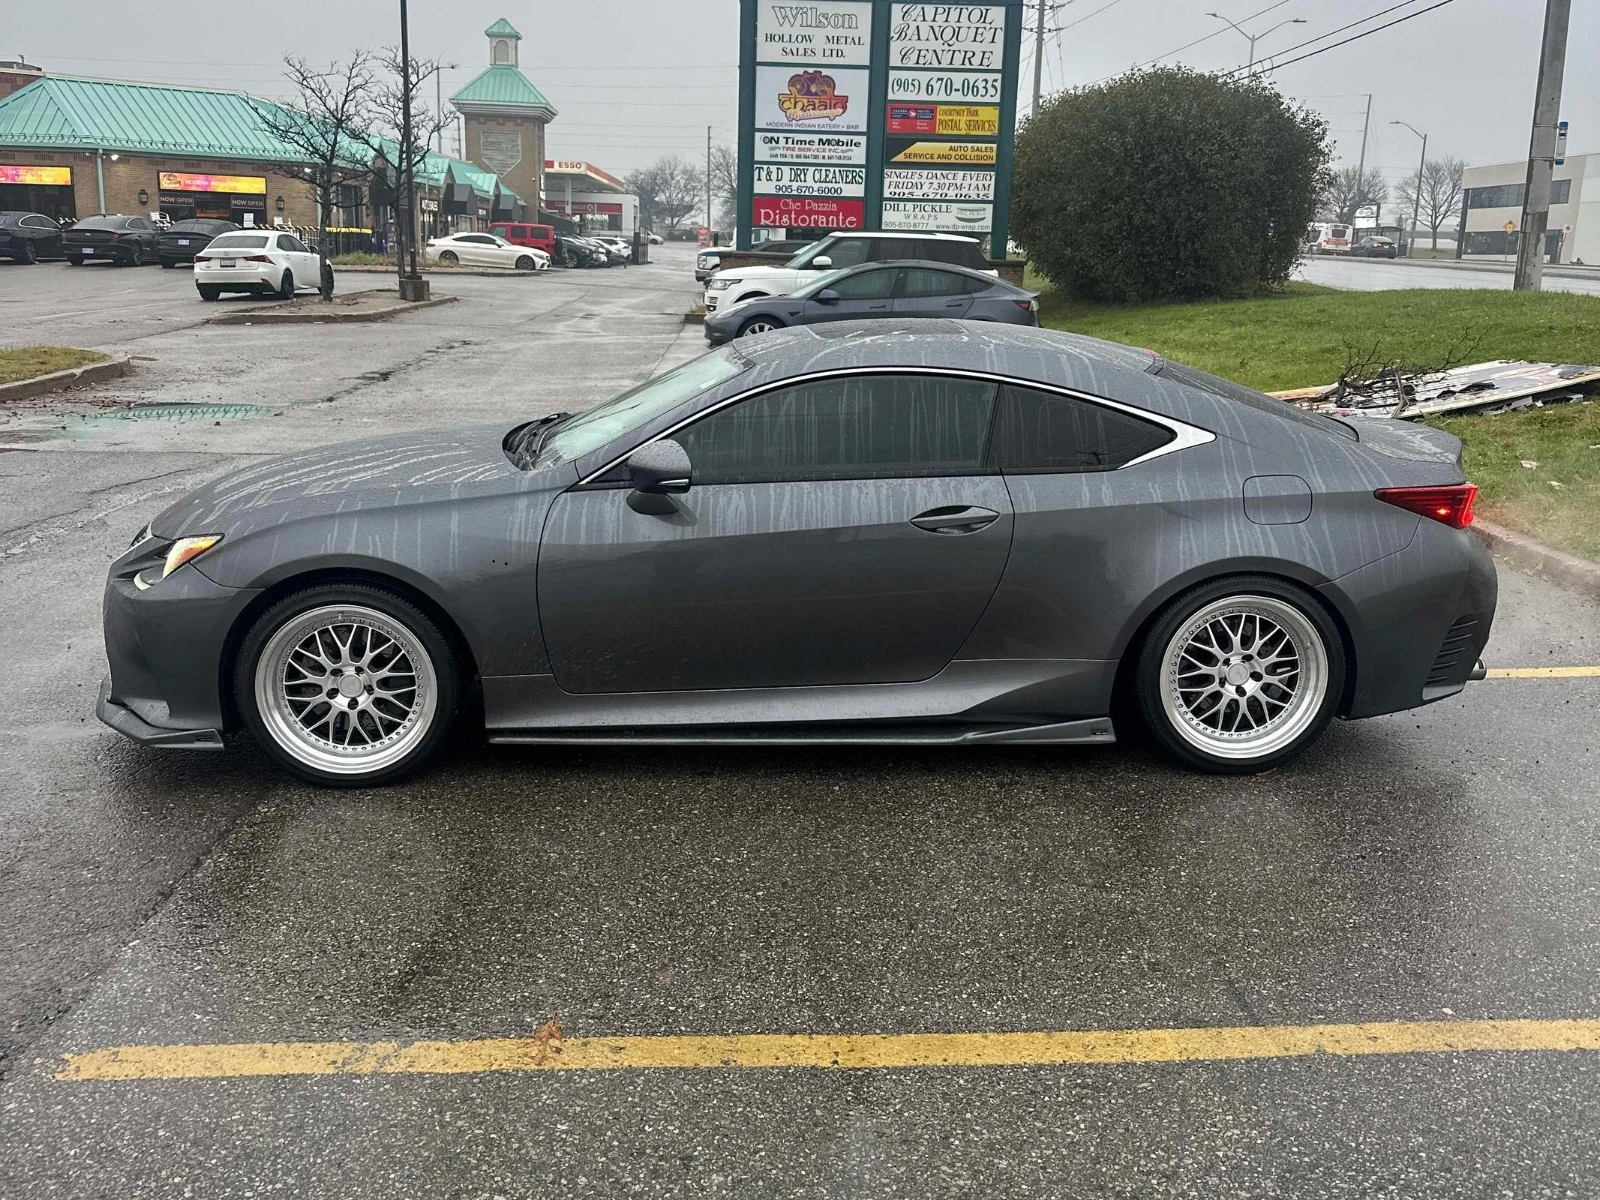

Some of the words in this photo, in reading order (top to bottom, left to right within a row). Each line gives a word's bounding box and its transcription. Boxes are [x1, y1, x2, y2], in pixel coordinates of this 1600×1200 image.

[772, 6, 858, 29] Wilson
[901, 4, 995, 25] CAPITOL
[764, 33, 814, 44] HOLLOW
[825, 35, 865, 46] METAL
[890, 23, 1003, 47] BANQUET
[781, 47, 816, 57] SALES
[822, 48, 845, 58] LTD.
[900, 46, 994, 68] CENTRE
[891, 77, 921, 96] (905)
[925, 77, 999, 98] 670-0635
[938, 118, 962, 132] POSTAL
[964, 119, 996, 133] SERVICES
[783, 136, 816, 146] Time
[948, 145, 968, 153] AUTO
[903, 152, 934, 160] SERVICE
[754, 166, 765, 182] T
[765, 166, 773, 182] &
[776, 166, 784, 182] D
[788, 167, 810, 183] DRY
[812, 168, 864, 185] CLEANERS
[884, 170, 923, 180] SINGLE'S
[926, 171, 959, 181] DANCE
[962, 172, 995, 182] EVERY
[774, 184, 843, 196] 905-670-6000
[888, 180, 926, 190] FRIDAY
[888, 191, 990, 199] 905-670-0635
[780, 198, 801, 210] Che
[805, 200, 837, 211] Pazzia
[884, 202, 910, 212] DILL
[912, 204, 952, 214] PICKLE
[760, 208, 857, 228] Ristorante
[883, 221, 929, 229] 905-670-8777
[935, 222, 991, 231] www.dp-wrap.com
